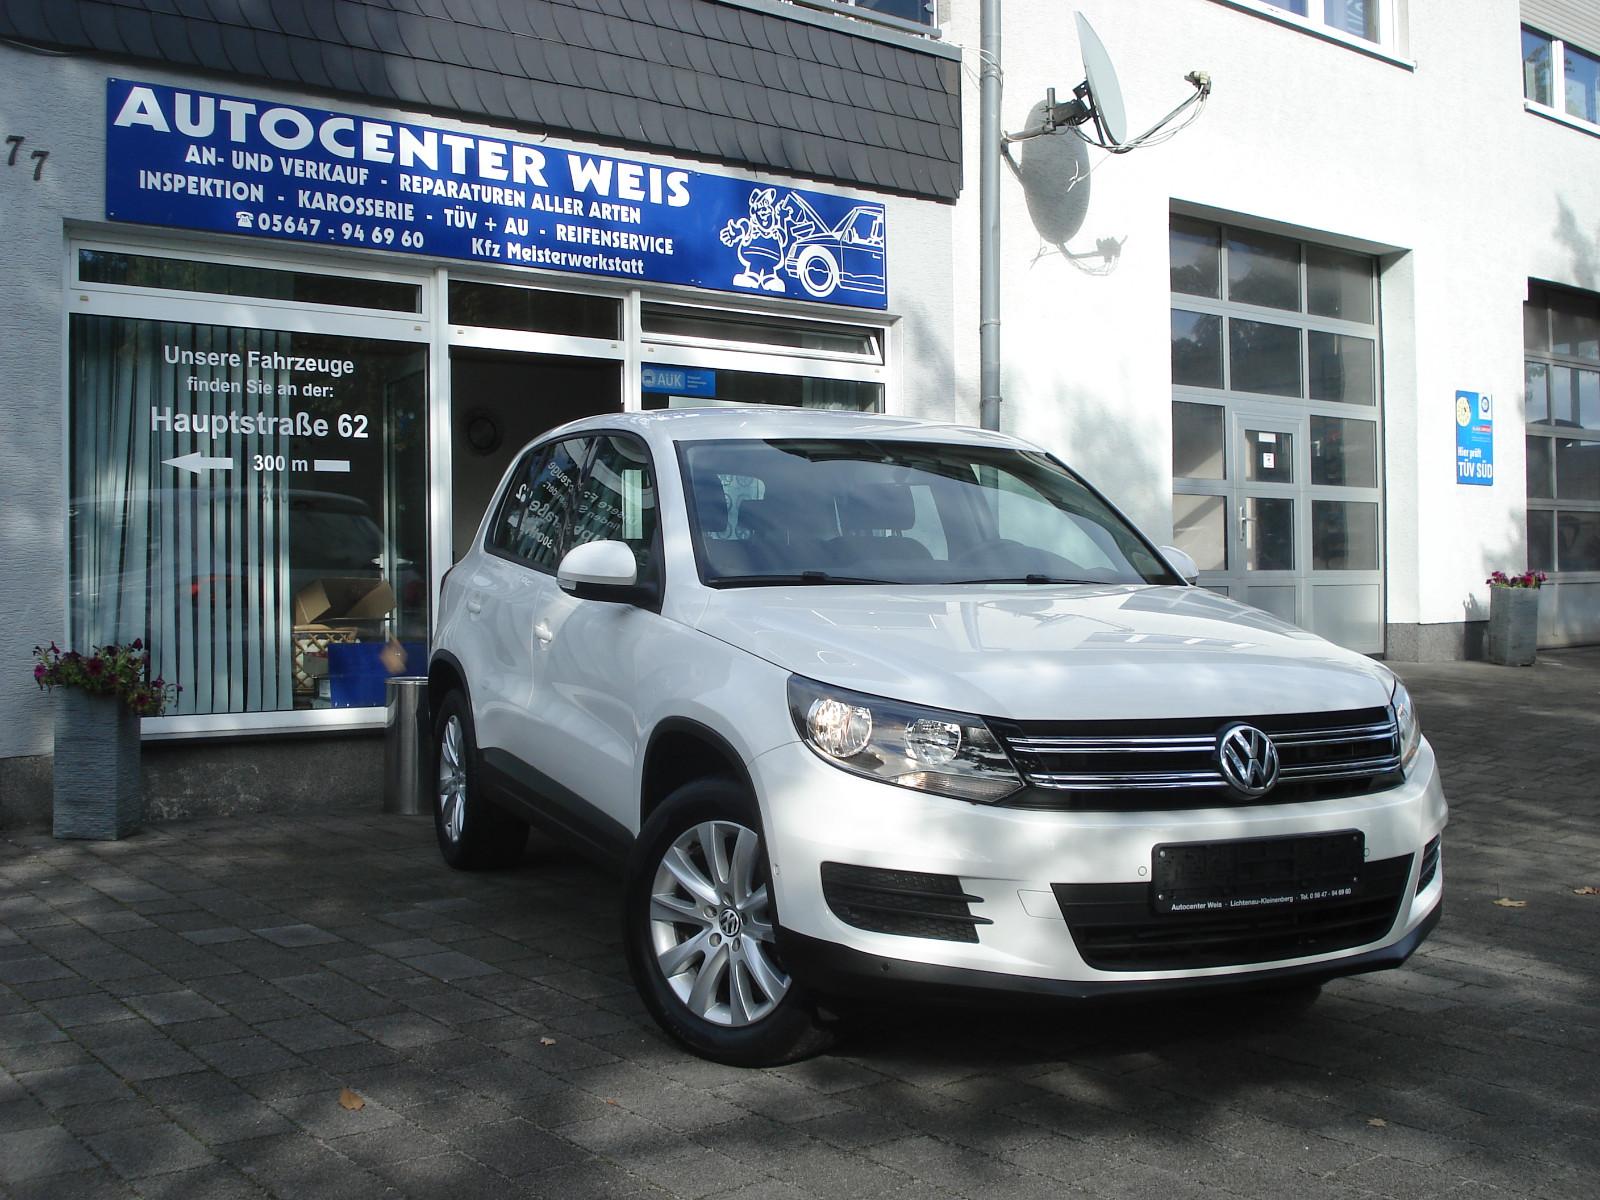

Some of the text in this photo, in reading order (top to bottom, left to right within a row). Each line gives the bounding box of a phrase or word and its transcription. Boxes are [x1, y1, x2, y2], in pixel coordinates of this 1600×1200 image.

[114, 86, 691, 208] AUTOCENTER WEIS
[185, 144, 224, 166] AN-
[232, 151, 273, 173] UND
[280, 156, 369, 185] VERKAUF
[400, 173, 526, 208] REPARATUREN
[531, 193, 584, 217] ALLER
[588, 201, 641, 225] ARTEN
[140, 170, 264, 203] INSPEKTION
[298, 190, 414, 222] KAROSSERIE
[444, 207, 477, 230] TÜV
[504, 217, 529, 237] AU
[556, 223, 674, 256] REIFENSERVICE
[258, 215, 320, 237] 05647
[342, 223, 365, 242] 94
[371, 226, 395, 245] 69
[401, 229, 425, 248] 60
[472, 237, 645, 276] Kfz Meisterwerkstatt
[164, 344, 354, 378] Unsere Fahrzeuge
[187, 375, 334, 398] finden Sie an der:
[657, 371, 682, 387] AUK
[151, 405, 369, 440] Hauptstraße 62
[253, 455, 308, 472] 300 m
[1458, 458, 1493, 479] TÜV SÜD
[1171, 902, 1206, 911] Autocenter
